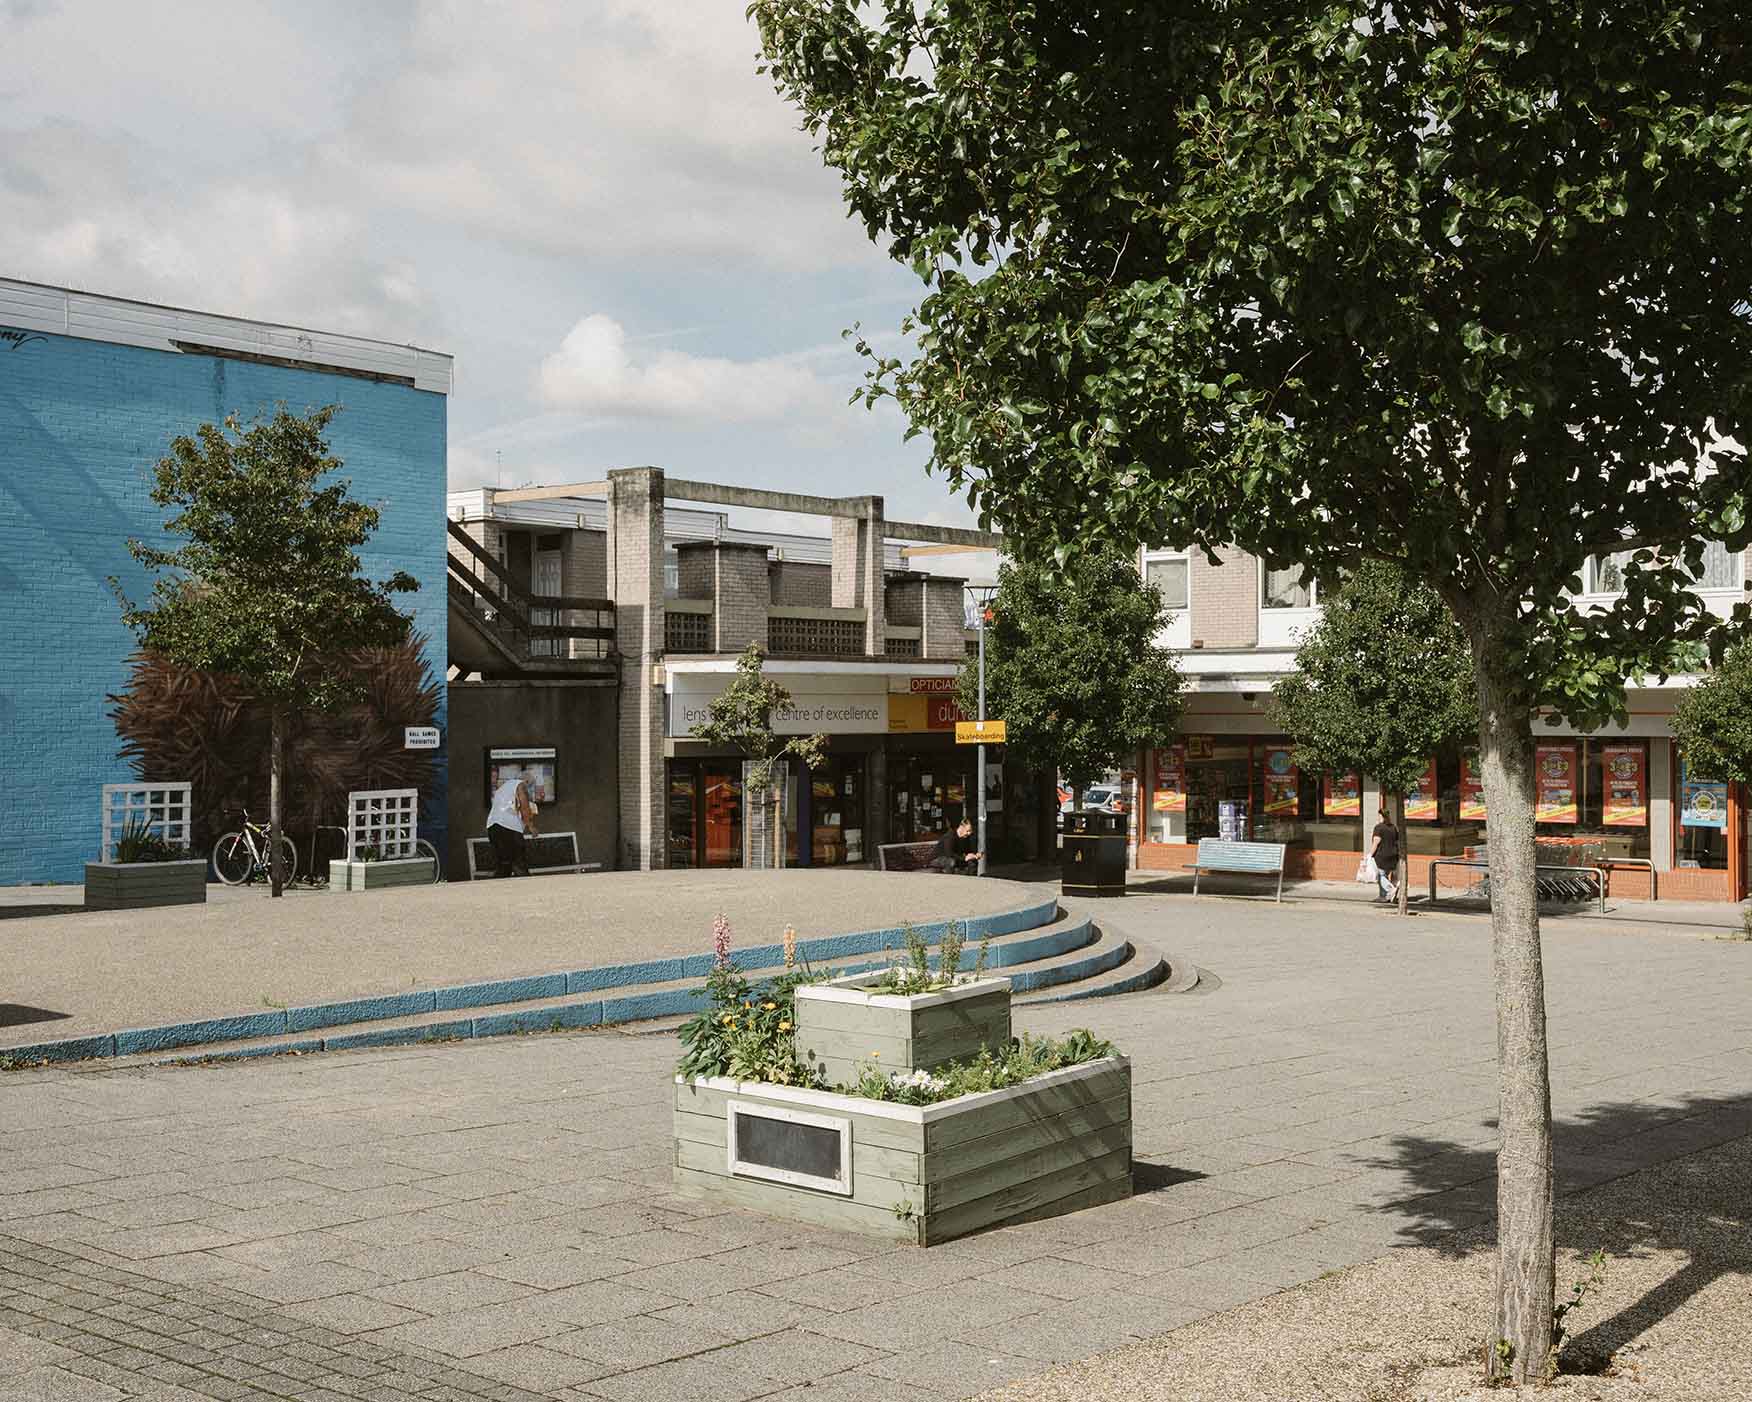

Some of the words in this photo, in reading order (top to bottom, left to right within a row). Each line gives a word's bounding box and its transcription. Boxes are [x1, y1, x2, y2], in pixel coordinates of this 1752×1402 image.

[683, 704, 706, 721] lens
[776, 708, 810, 721] centre
[813, 705, 825, 721] of
[826, 706, 879, 721] excellence
